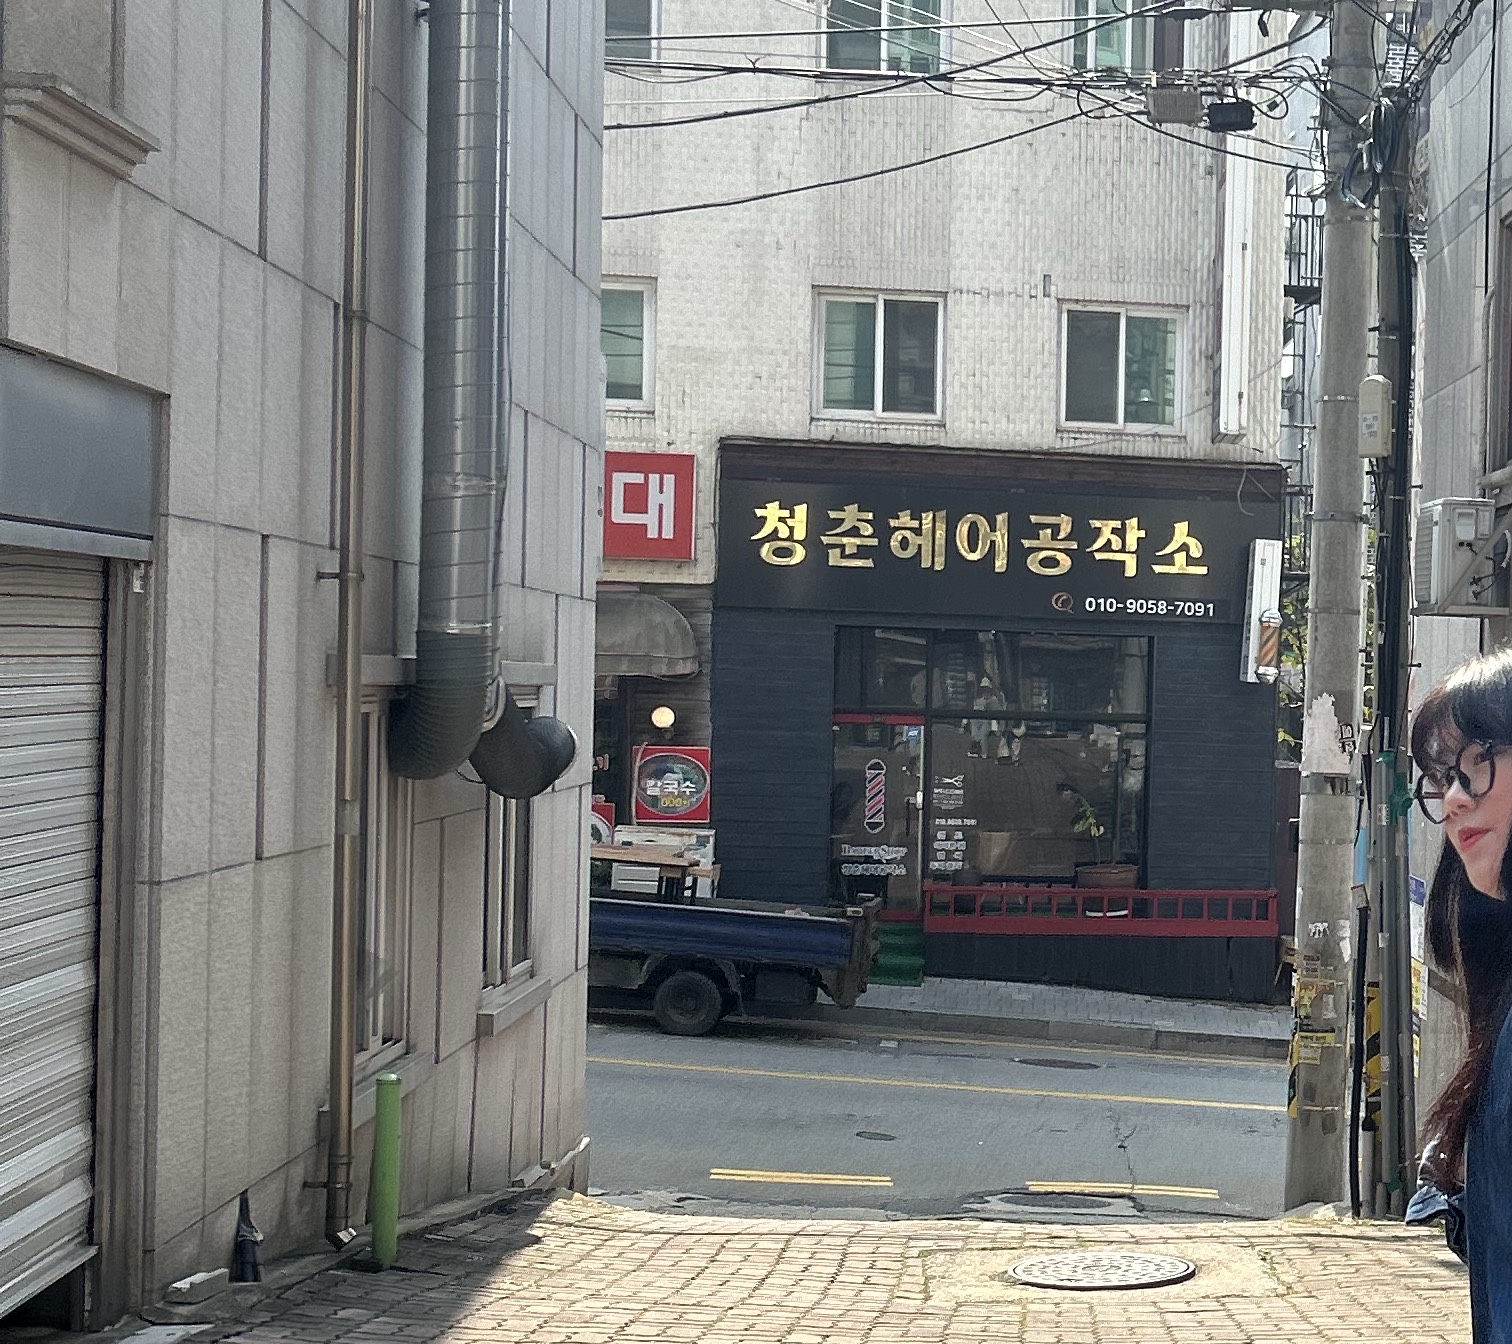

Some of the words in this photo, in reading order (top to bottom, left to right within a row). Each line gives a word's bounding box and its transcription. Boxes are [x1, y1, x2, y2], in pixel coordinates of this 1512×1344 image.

[610, 471, 676, 540] 대
[750, 500, 1209, 578] 청춘헤어공작소
[1084, 596, 1216, 617] 010-9058-7091
